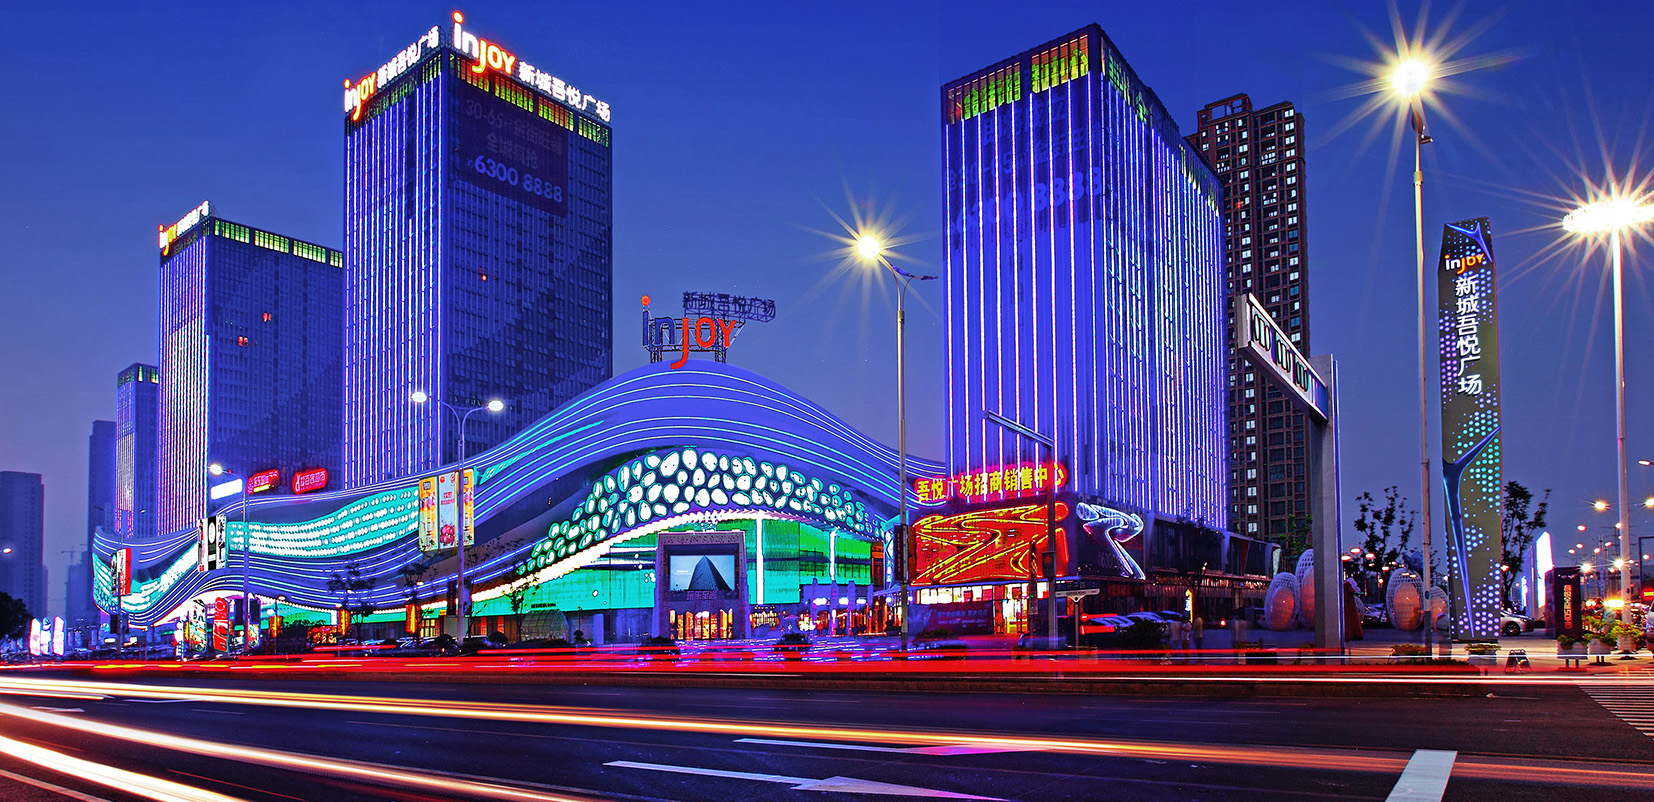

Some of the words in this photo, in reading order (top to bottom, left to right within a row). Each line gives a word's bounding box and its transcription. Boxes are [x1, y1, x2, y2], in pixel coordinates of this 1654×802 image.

[519, 60, 612, 123] 新城吾悦广场
[474, 154, 519, 186] 6300
[522, 172, 563, 204] 8888
[682, 291, 777, 317] 新城吾悦广场
[1454, 274, 1482, 396] 新城吾悦广场
[916, 462, 1065, 503] 吾悦广场招商销售中心
